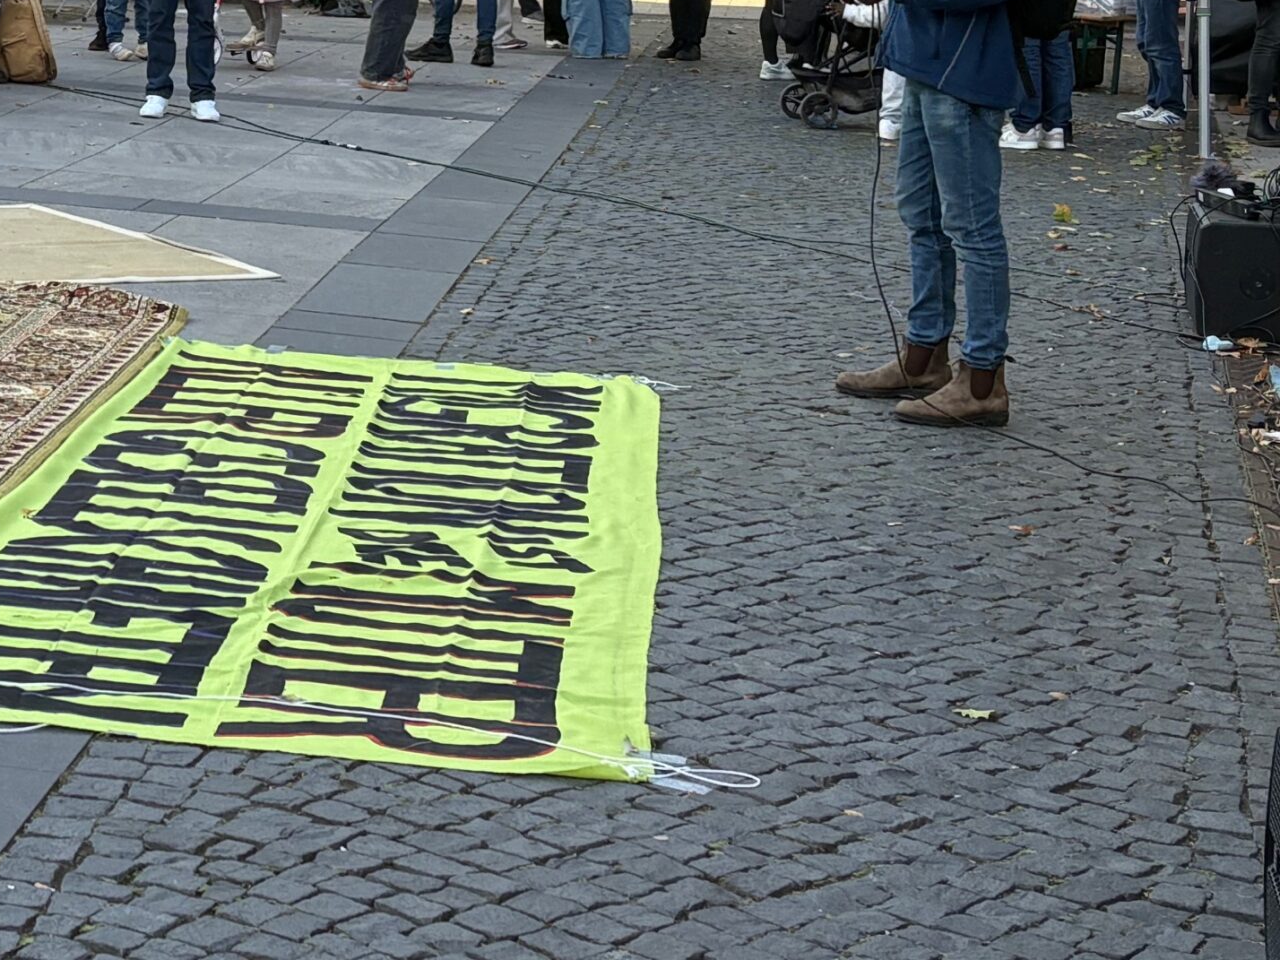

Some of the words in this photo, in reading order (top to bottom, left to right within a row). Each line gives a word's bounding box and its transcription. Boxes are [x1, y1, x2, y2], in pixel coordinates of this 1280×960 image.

[114, 349, 374, 439] ALLER
[328, 372, 604, 538] MIGRATION
[337, 526, 475, 569] DIE
[477, 530, 596, 573] IST
[213, 560, 577, 761] MUTTER
